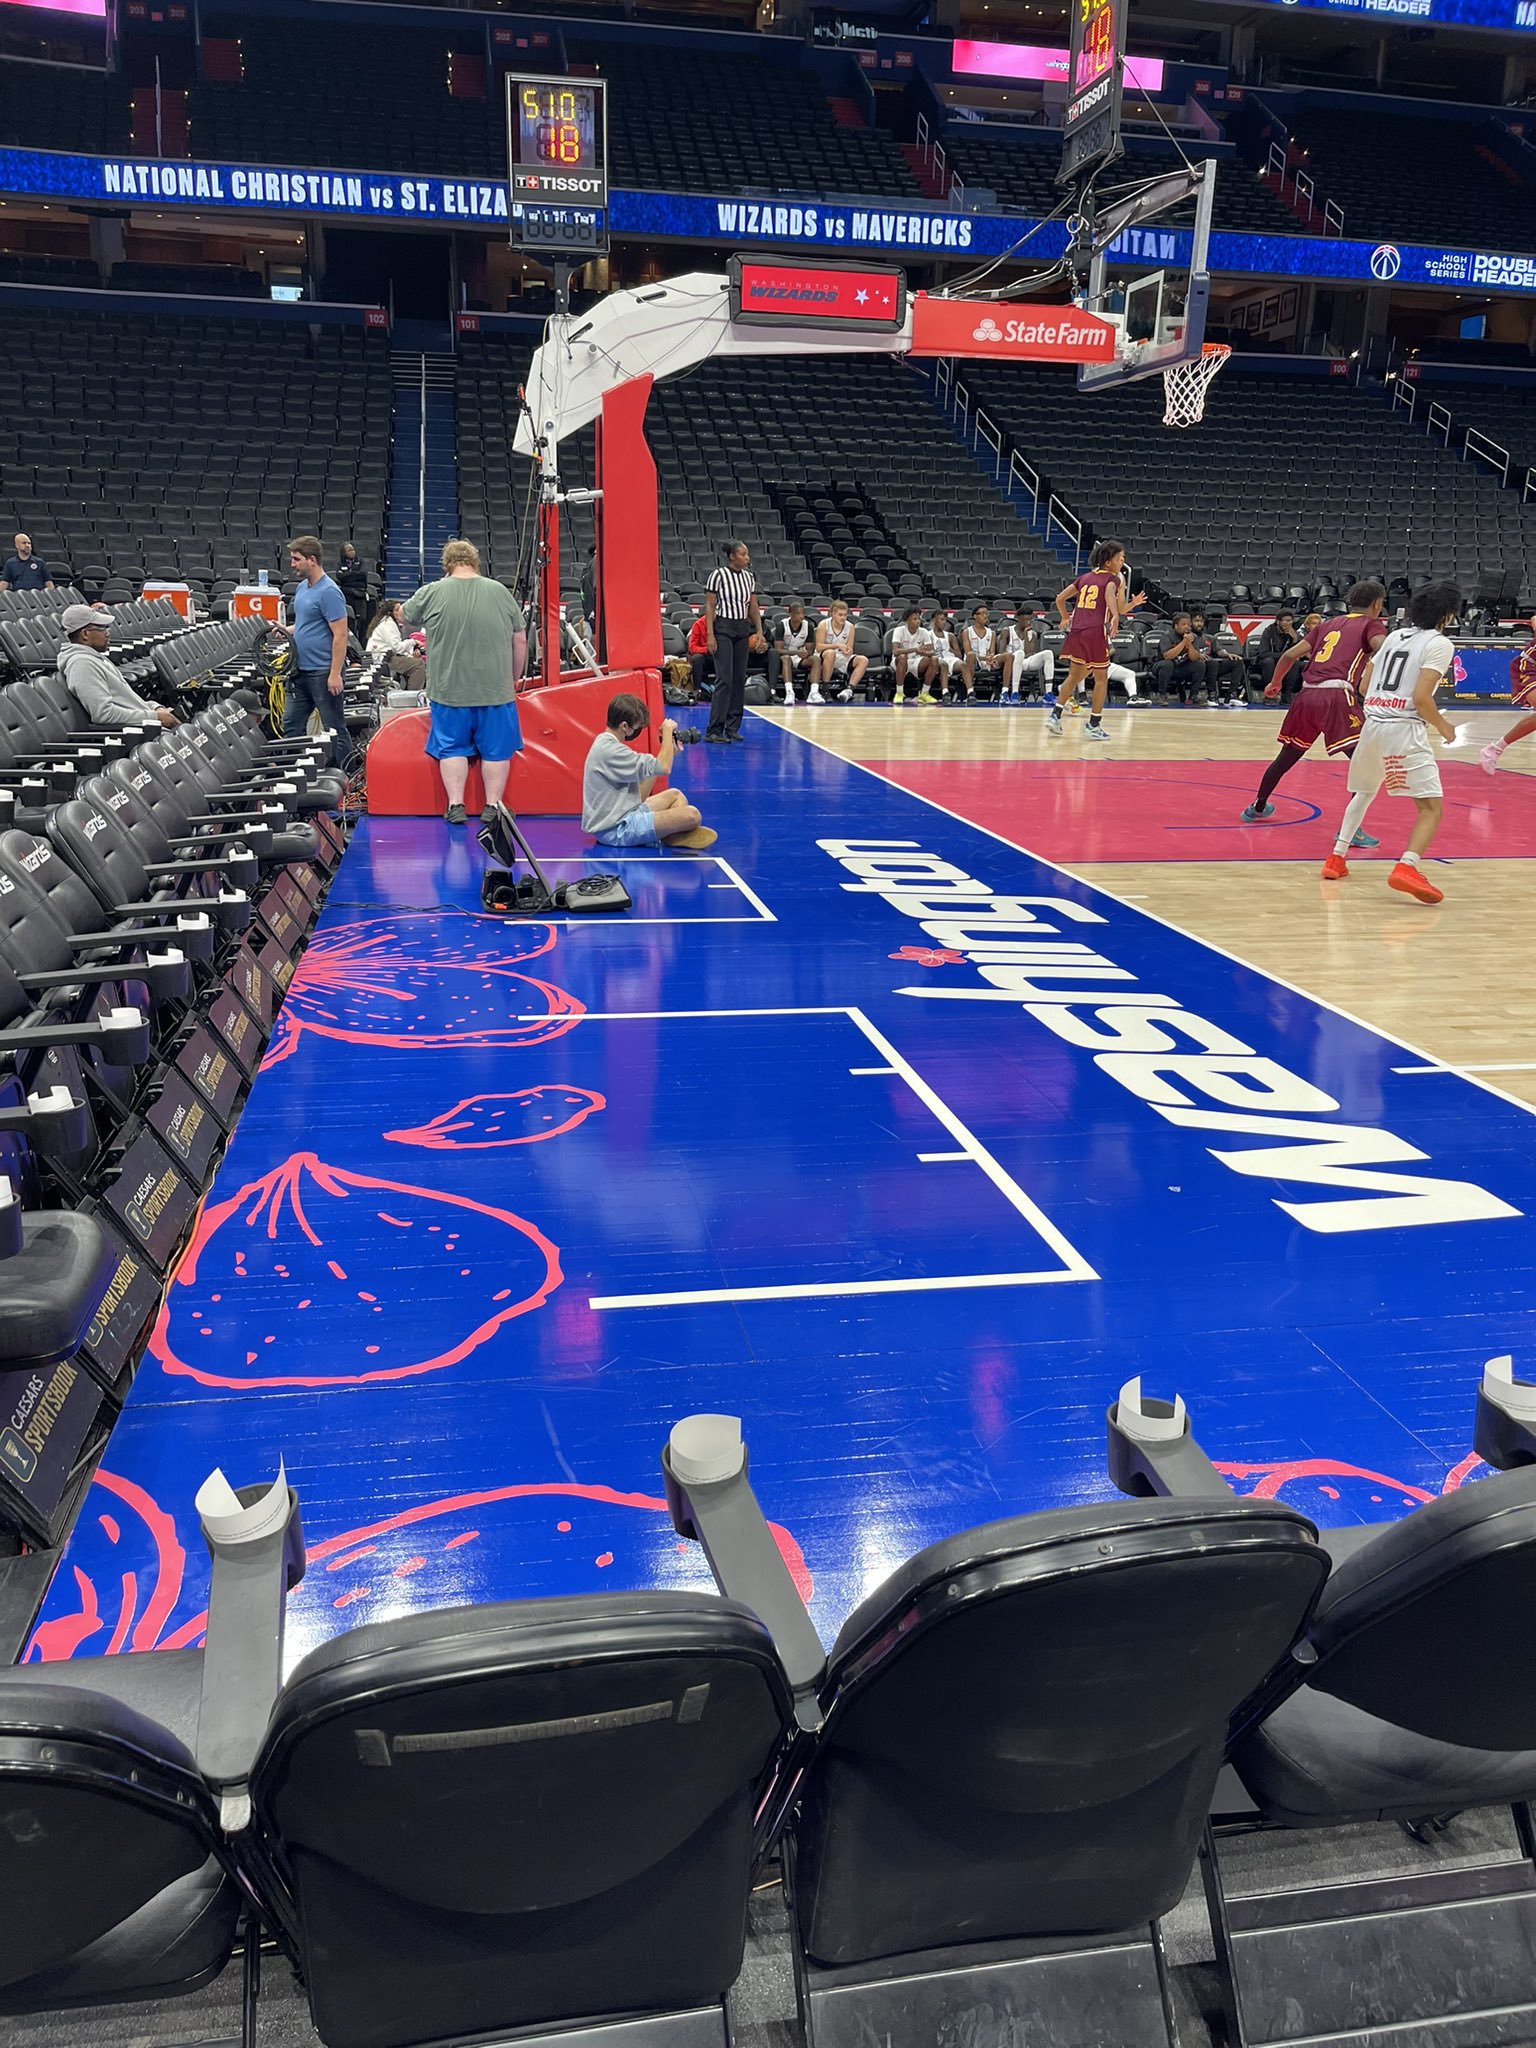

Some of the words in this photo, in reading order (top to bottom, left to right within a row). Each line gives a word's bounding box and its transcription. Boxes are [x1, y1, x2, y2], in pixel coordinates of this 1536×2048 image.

[1365, 0, 1432, 16] HEADER
[523, 89, 575, 121] 51.0
[104, 164, 225, 198] NATIONAL
[231, 171, 363, 208] CHRISTIAN
[401, 182, 436, 212] ST.
[540, 176, 602, 194] TISSOT
[717, 203, 818, 237] WIZARDS
[852, 212, 972, 247] MAVERICKS
[1425, 260, 1467, 272] SCHOOL
[1442, 254, 1468, 264] HIGH
[751, 279, 840, 291] WASHINGTON
[1430, 269, 1466, 279] SERIES
[750, 286, 840, 303] WIZARDS
[369, 314, 385, 324] 102
[460, 320, 475, 329] 101
[1333, 364, 1347, 374] 100
[1406, 368, 1419, 377] 121
[1077, 584, 1099, 610] 12
[1314, 630, 1341, 663] 3
[1376, 649, 1409, 692] 10
[170, 1104, 187, 1131] CAESARS
[179, 1100, 206, 1147] SPORTSBOOK
[133, 1172, 157, 1207] CAESARS
[142, 1167, 181, 1226] SPORTSBOOK
[95, 1253, 140, 1327] SPORTSBOOK
[11, 1373, 45, 1431] CAESARS
[24, 1359, 79, 1454] SPORTSBOOK
